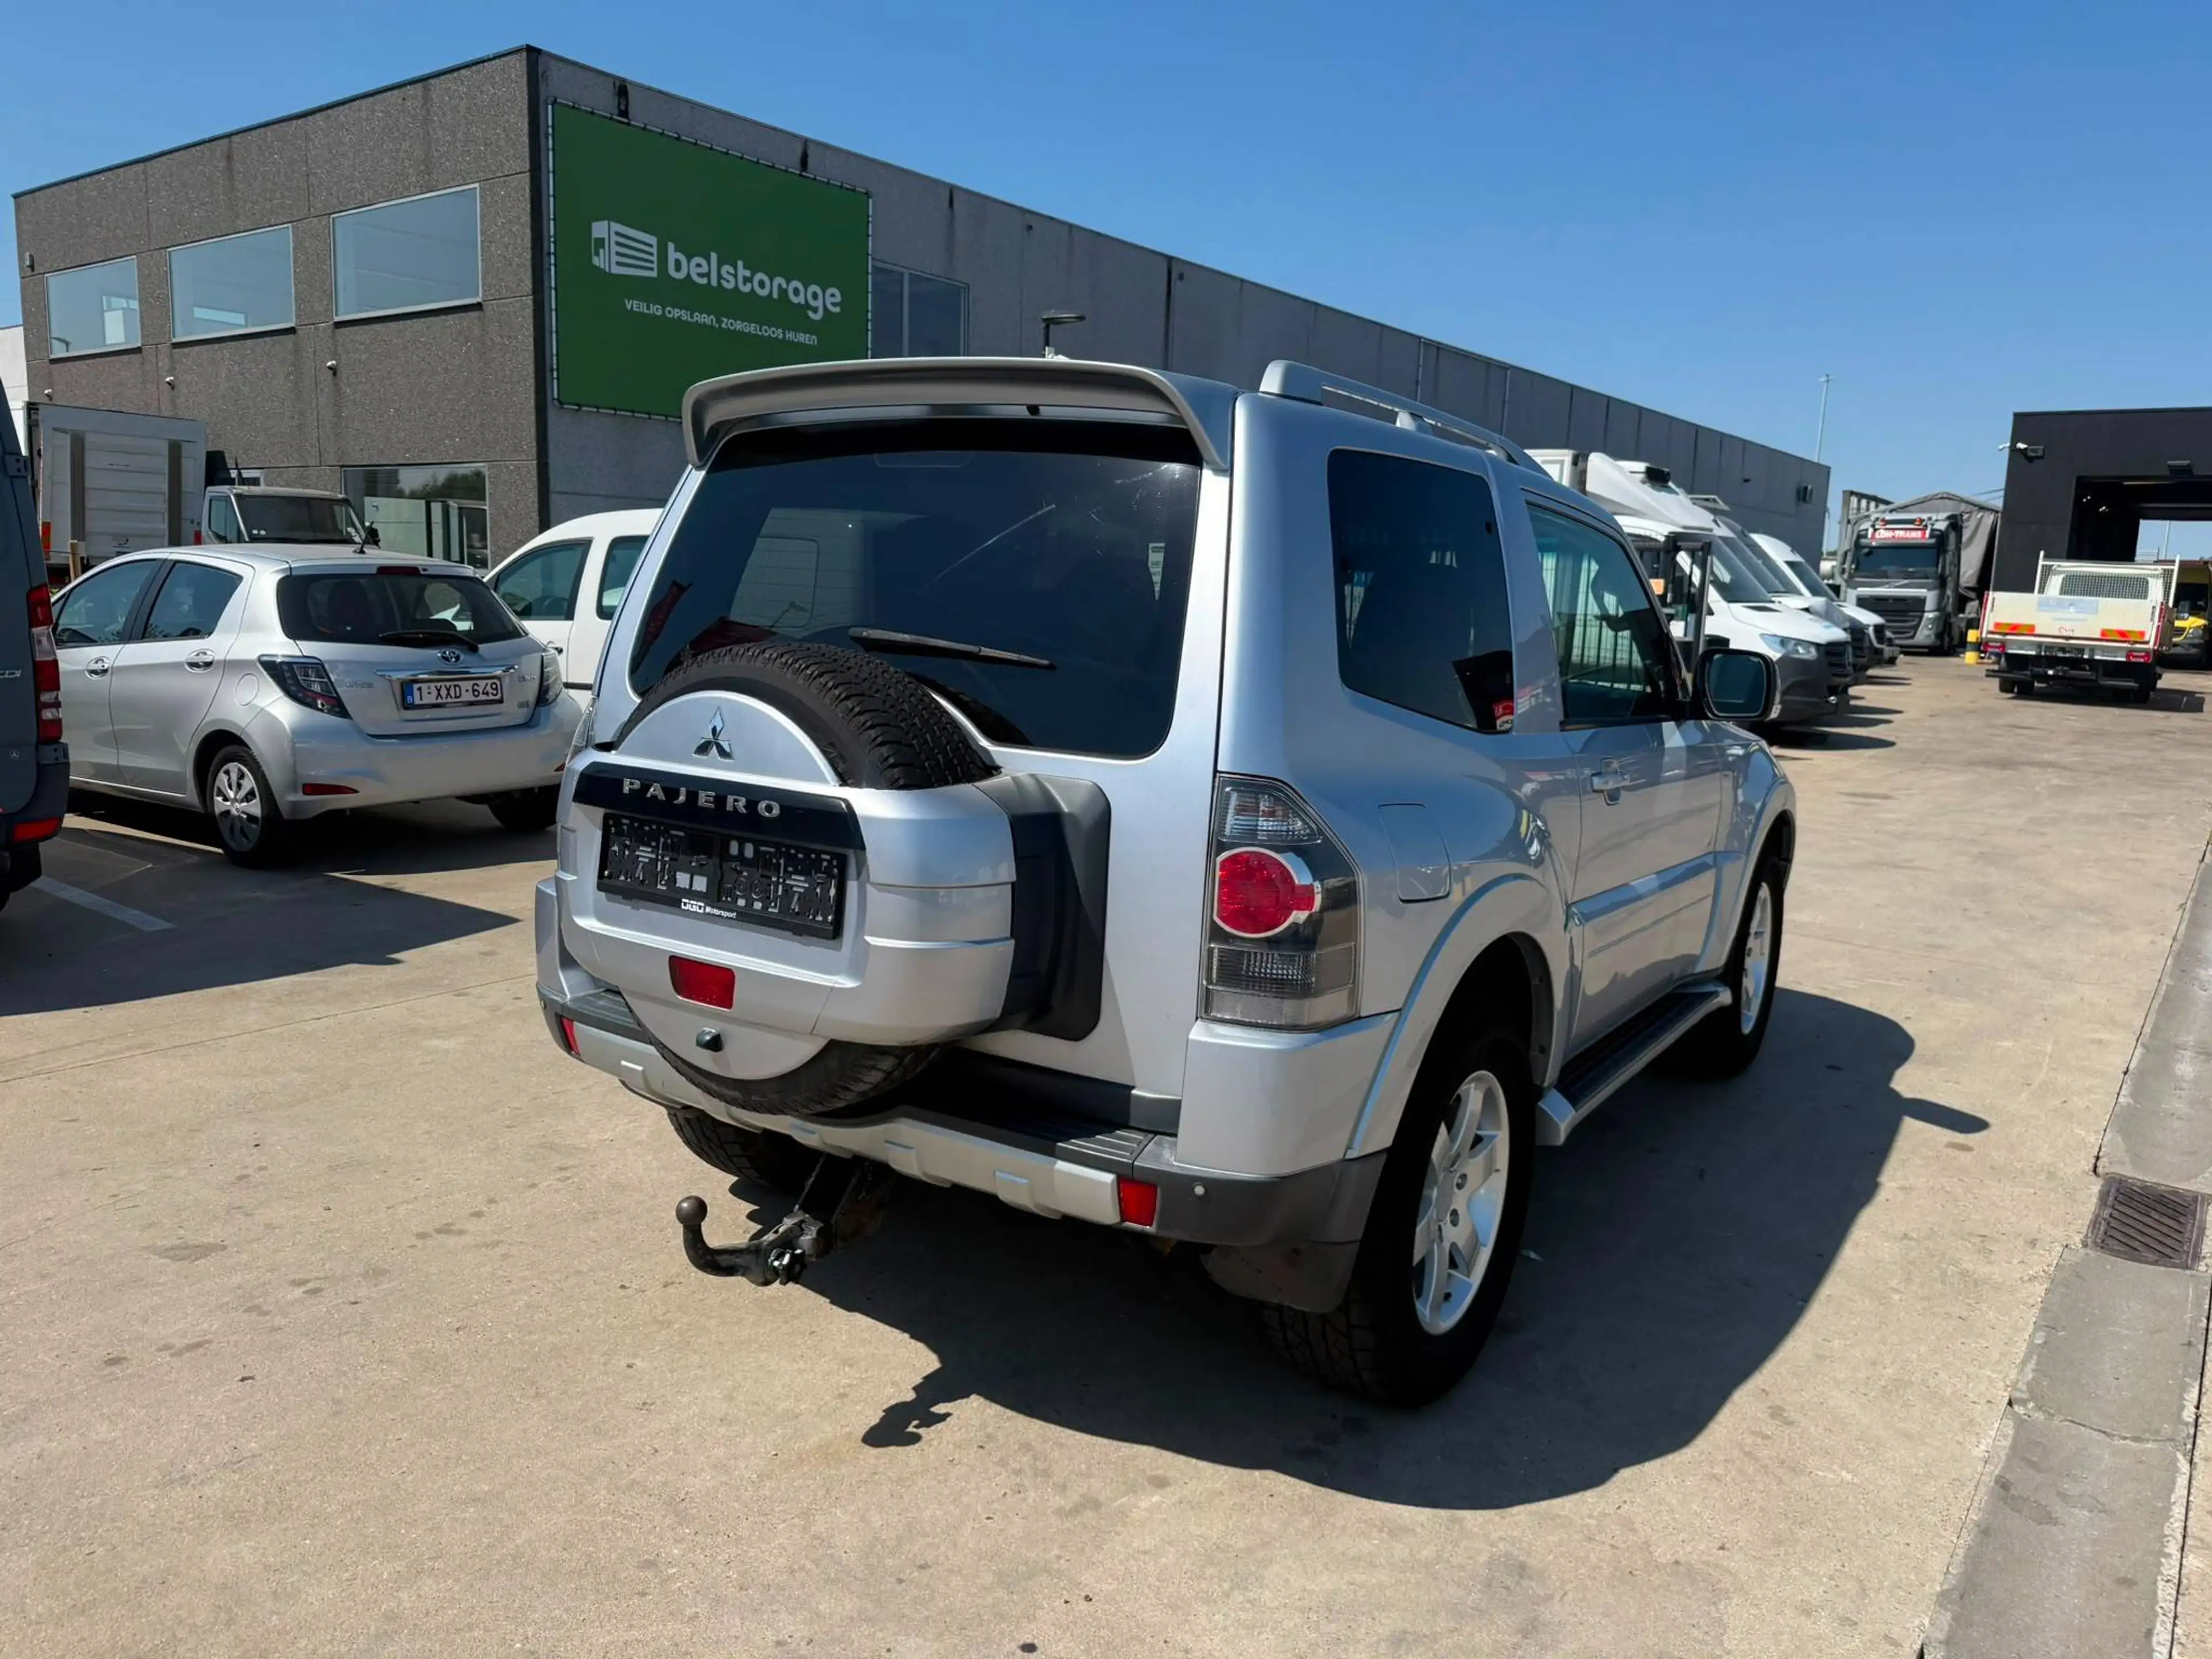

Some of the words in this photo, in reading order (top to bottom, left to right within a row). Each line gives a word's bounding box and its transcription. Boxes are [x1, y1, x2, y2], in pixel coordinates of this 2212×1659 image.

[667, 242, 842, 321] belstorage
[624, 298, 662, 316] VEILIG
[665, 306, 719, 329] OPSLAAN,
[721, 317, 784, 340] ZORGELOOS
[785, 329, 818, 346] HUREN
[623, 778, 781, 818] PAJERO
[705, 906, 737, 919] Motorsport
